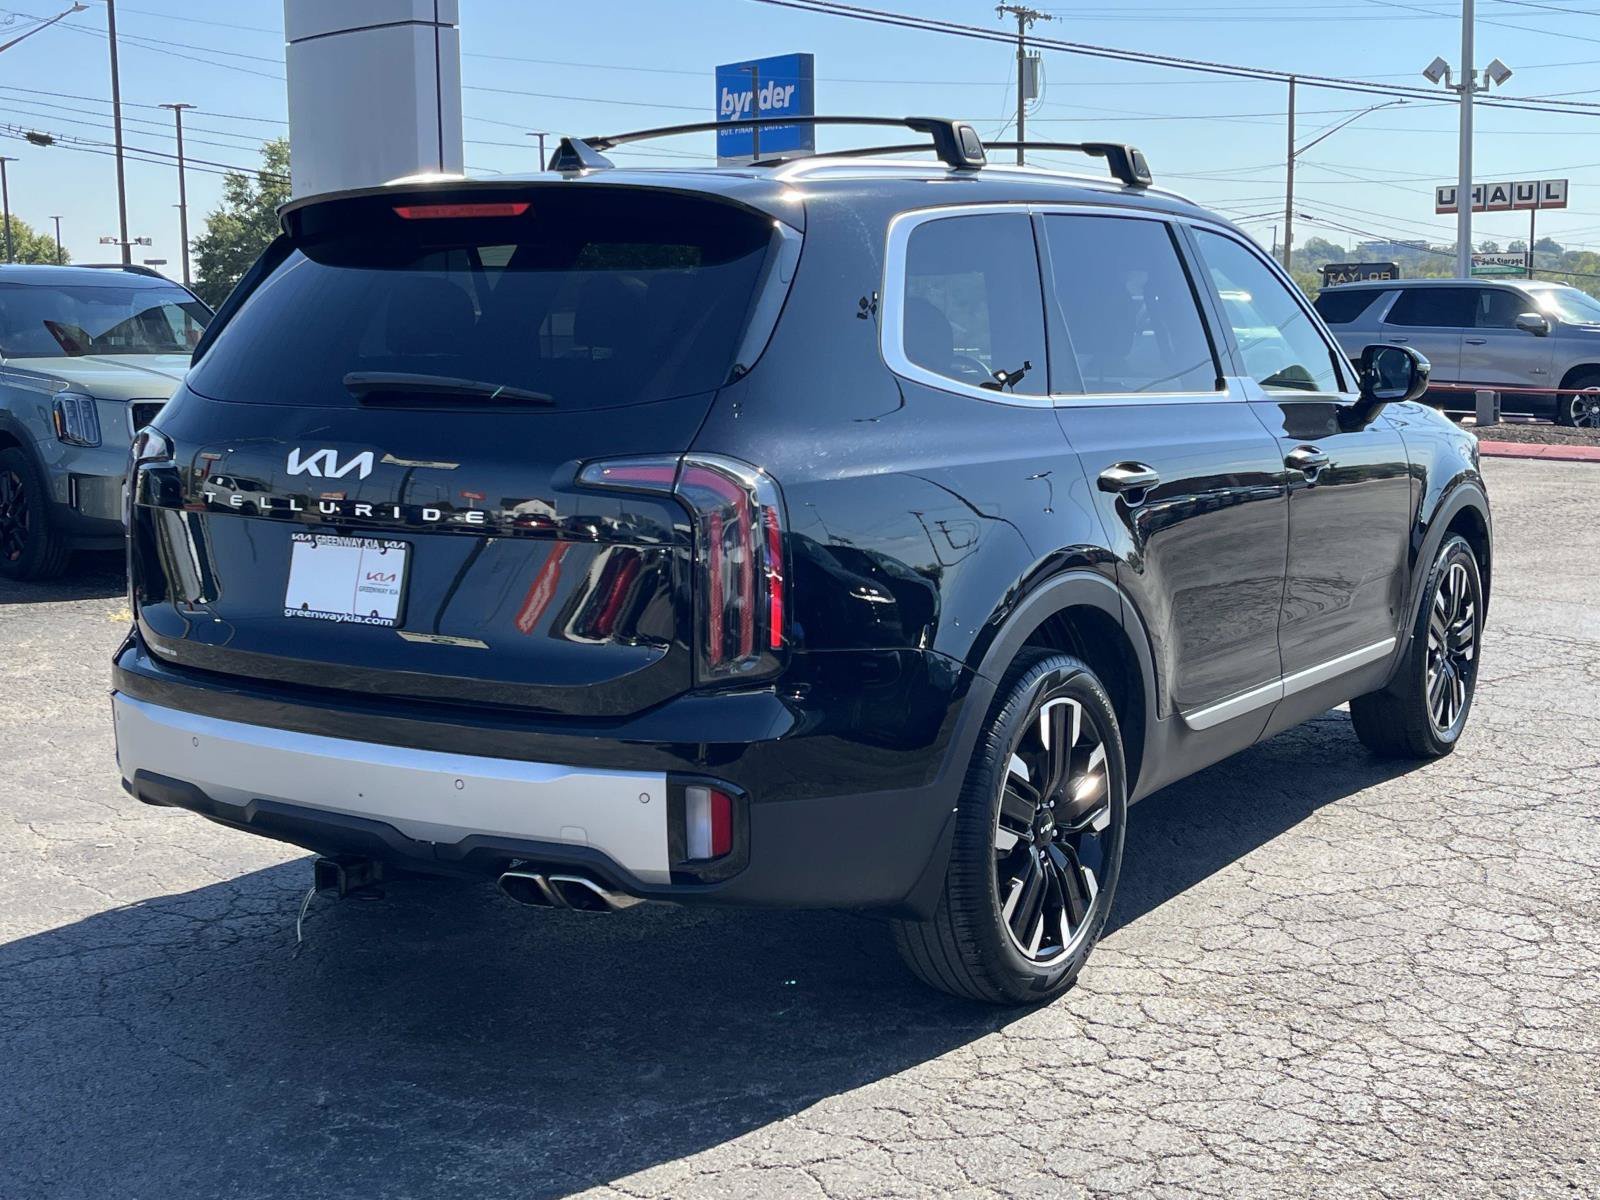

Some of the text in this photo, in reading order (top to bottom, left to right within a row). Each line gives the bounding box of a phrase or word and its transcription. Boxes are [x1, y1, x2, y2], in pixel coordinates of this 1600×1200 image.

[720, 80, 795, 121] byrder
[1496, 257, 1524, 267] Storage
[1327, 271, 1391, 284] TAYLOR
[286, 447, 375, 480] KIA
[204, 490, 485, 525] TELLURIDE
[291, 533, 406, 550] KIA GREENWAY KIA KIA
[366, 572, 396, 583] KIA
[283, 607, 394, 627] greenwaykia.com
